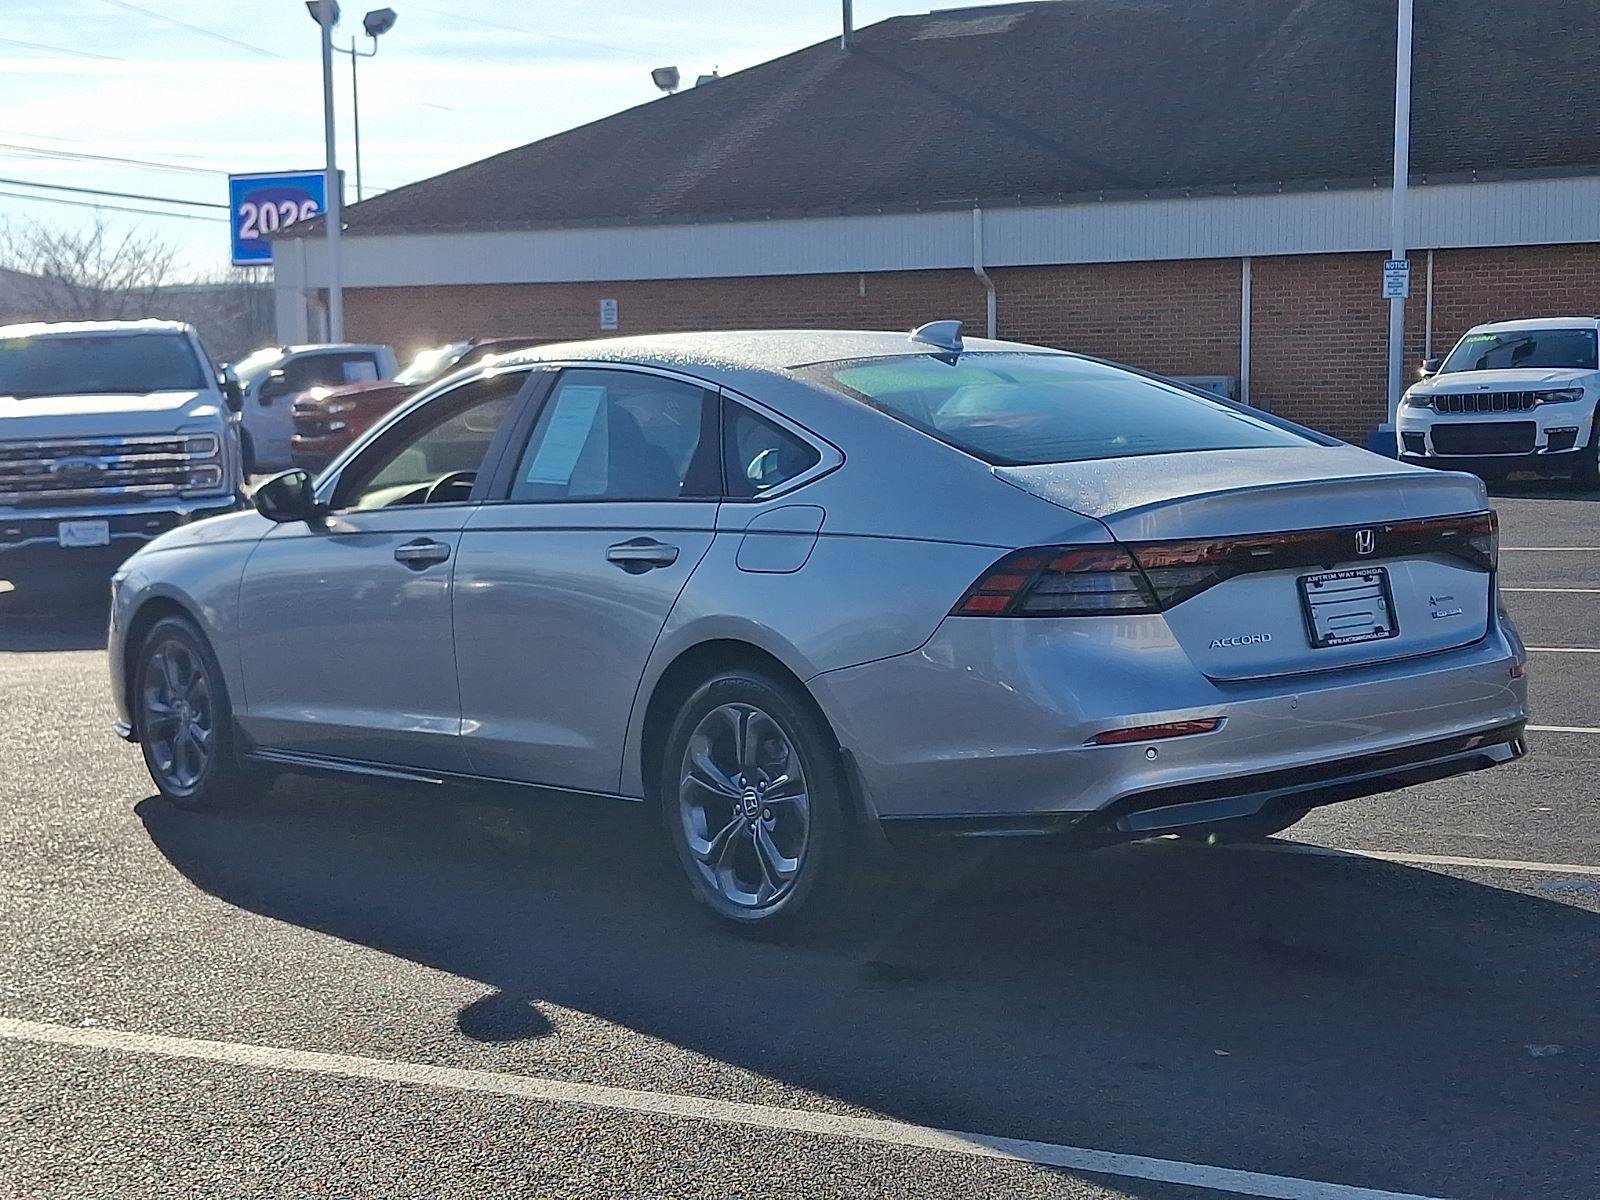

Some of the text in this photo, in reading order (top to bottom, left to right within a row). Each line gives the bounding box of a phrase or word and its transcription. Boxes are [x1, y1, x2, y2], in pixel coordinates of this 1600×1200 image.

[1385, 261, 1409, 270] NOTICE
[1307, 568, 1383, 582] ANTRIM WAY HONDA
[1209, 633, 1272, 649] ACCORD
